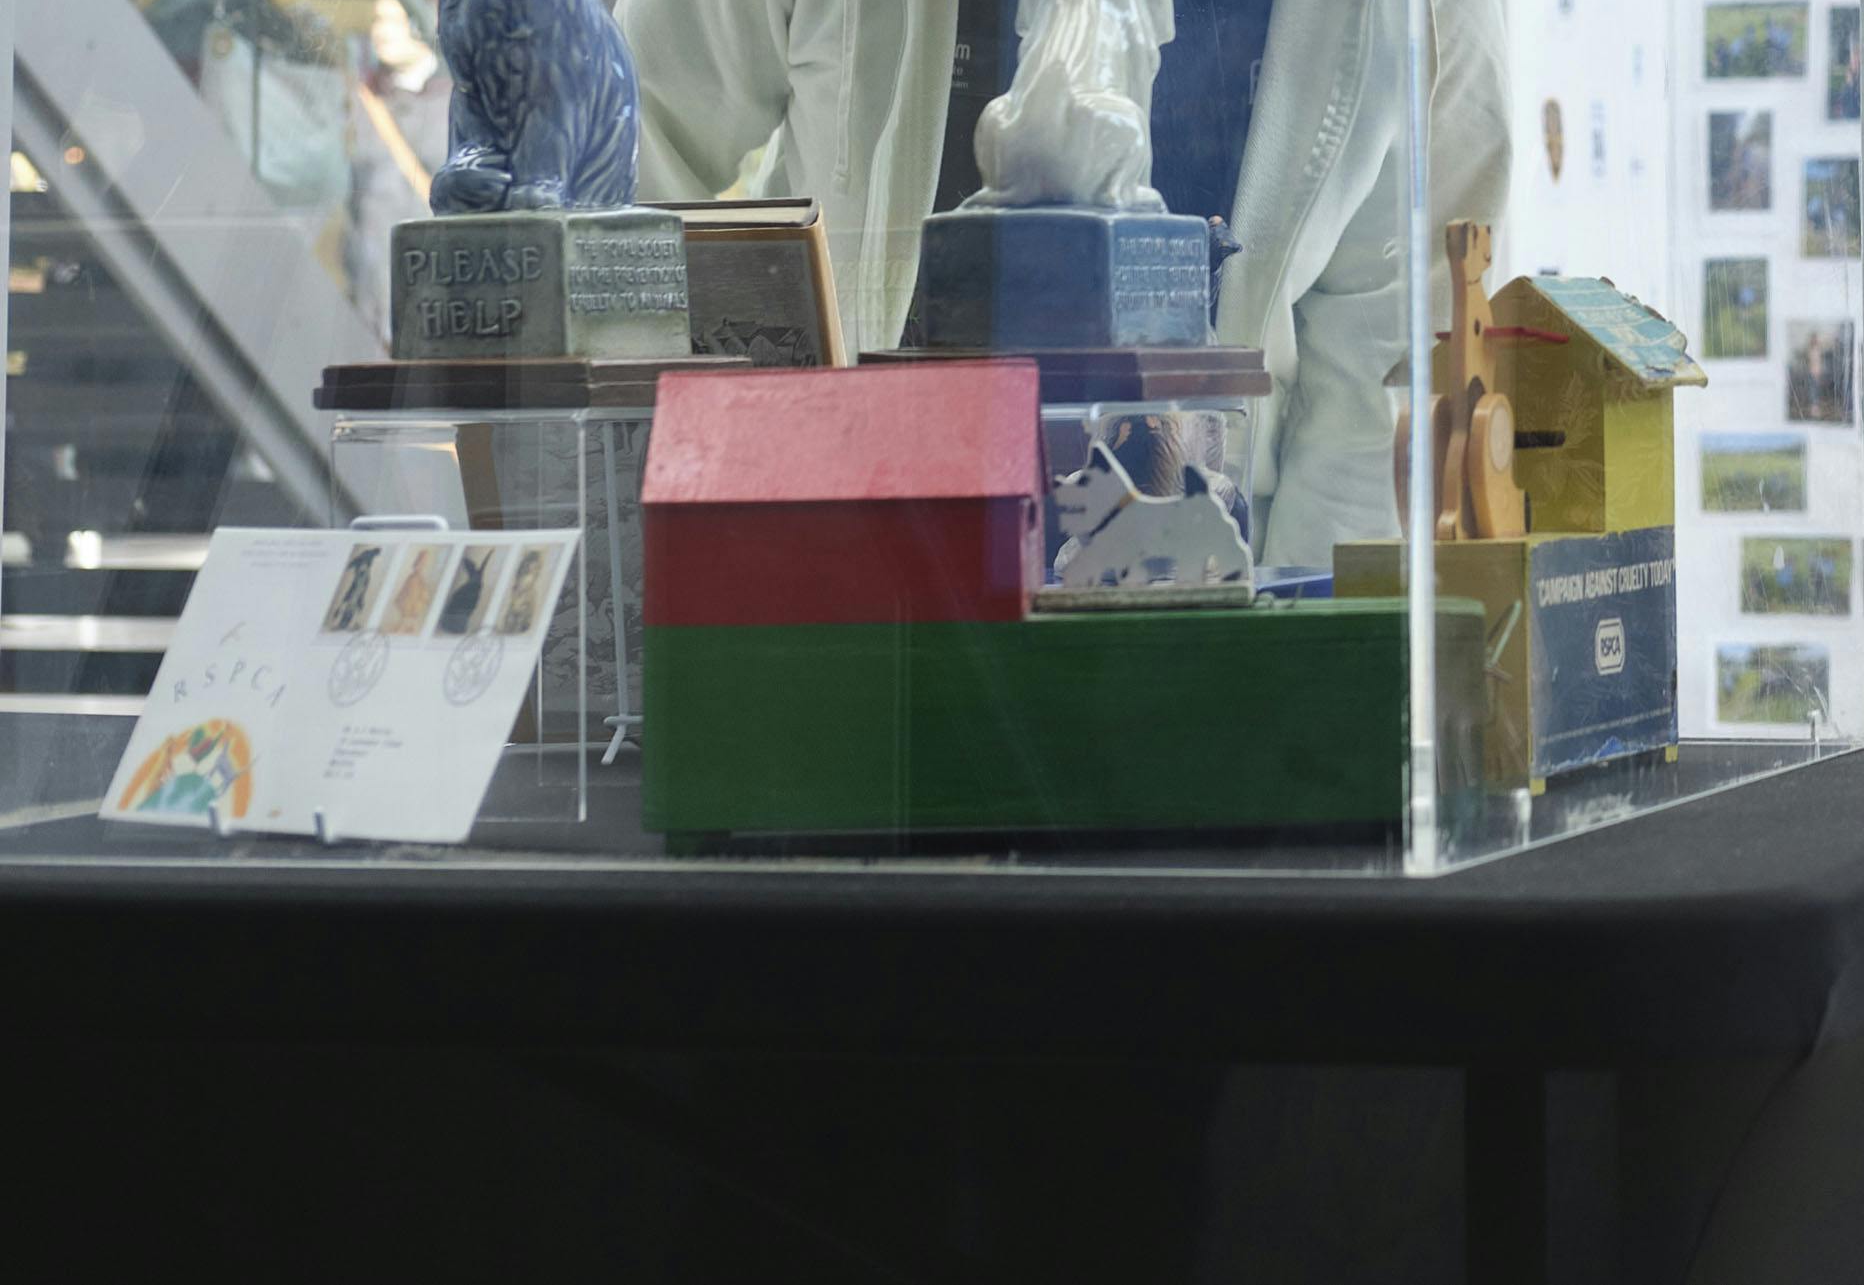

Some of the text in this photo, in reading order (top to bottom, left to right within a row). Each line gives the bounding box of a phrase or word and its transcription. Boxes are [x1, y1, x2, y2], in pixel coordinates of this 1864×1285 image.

[403, 246, 542, 286] PLEASE
[417, 296, 525, 339] HELP
[1584, 568, 1617, 599] AGAINST
[1618, 563, 1648, 593] CRUELTY
